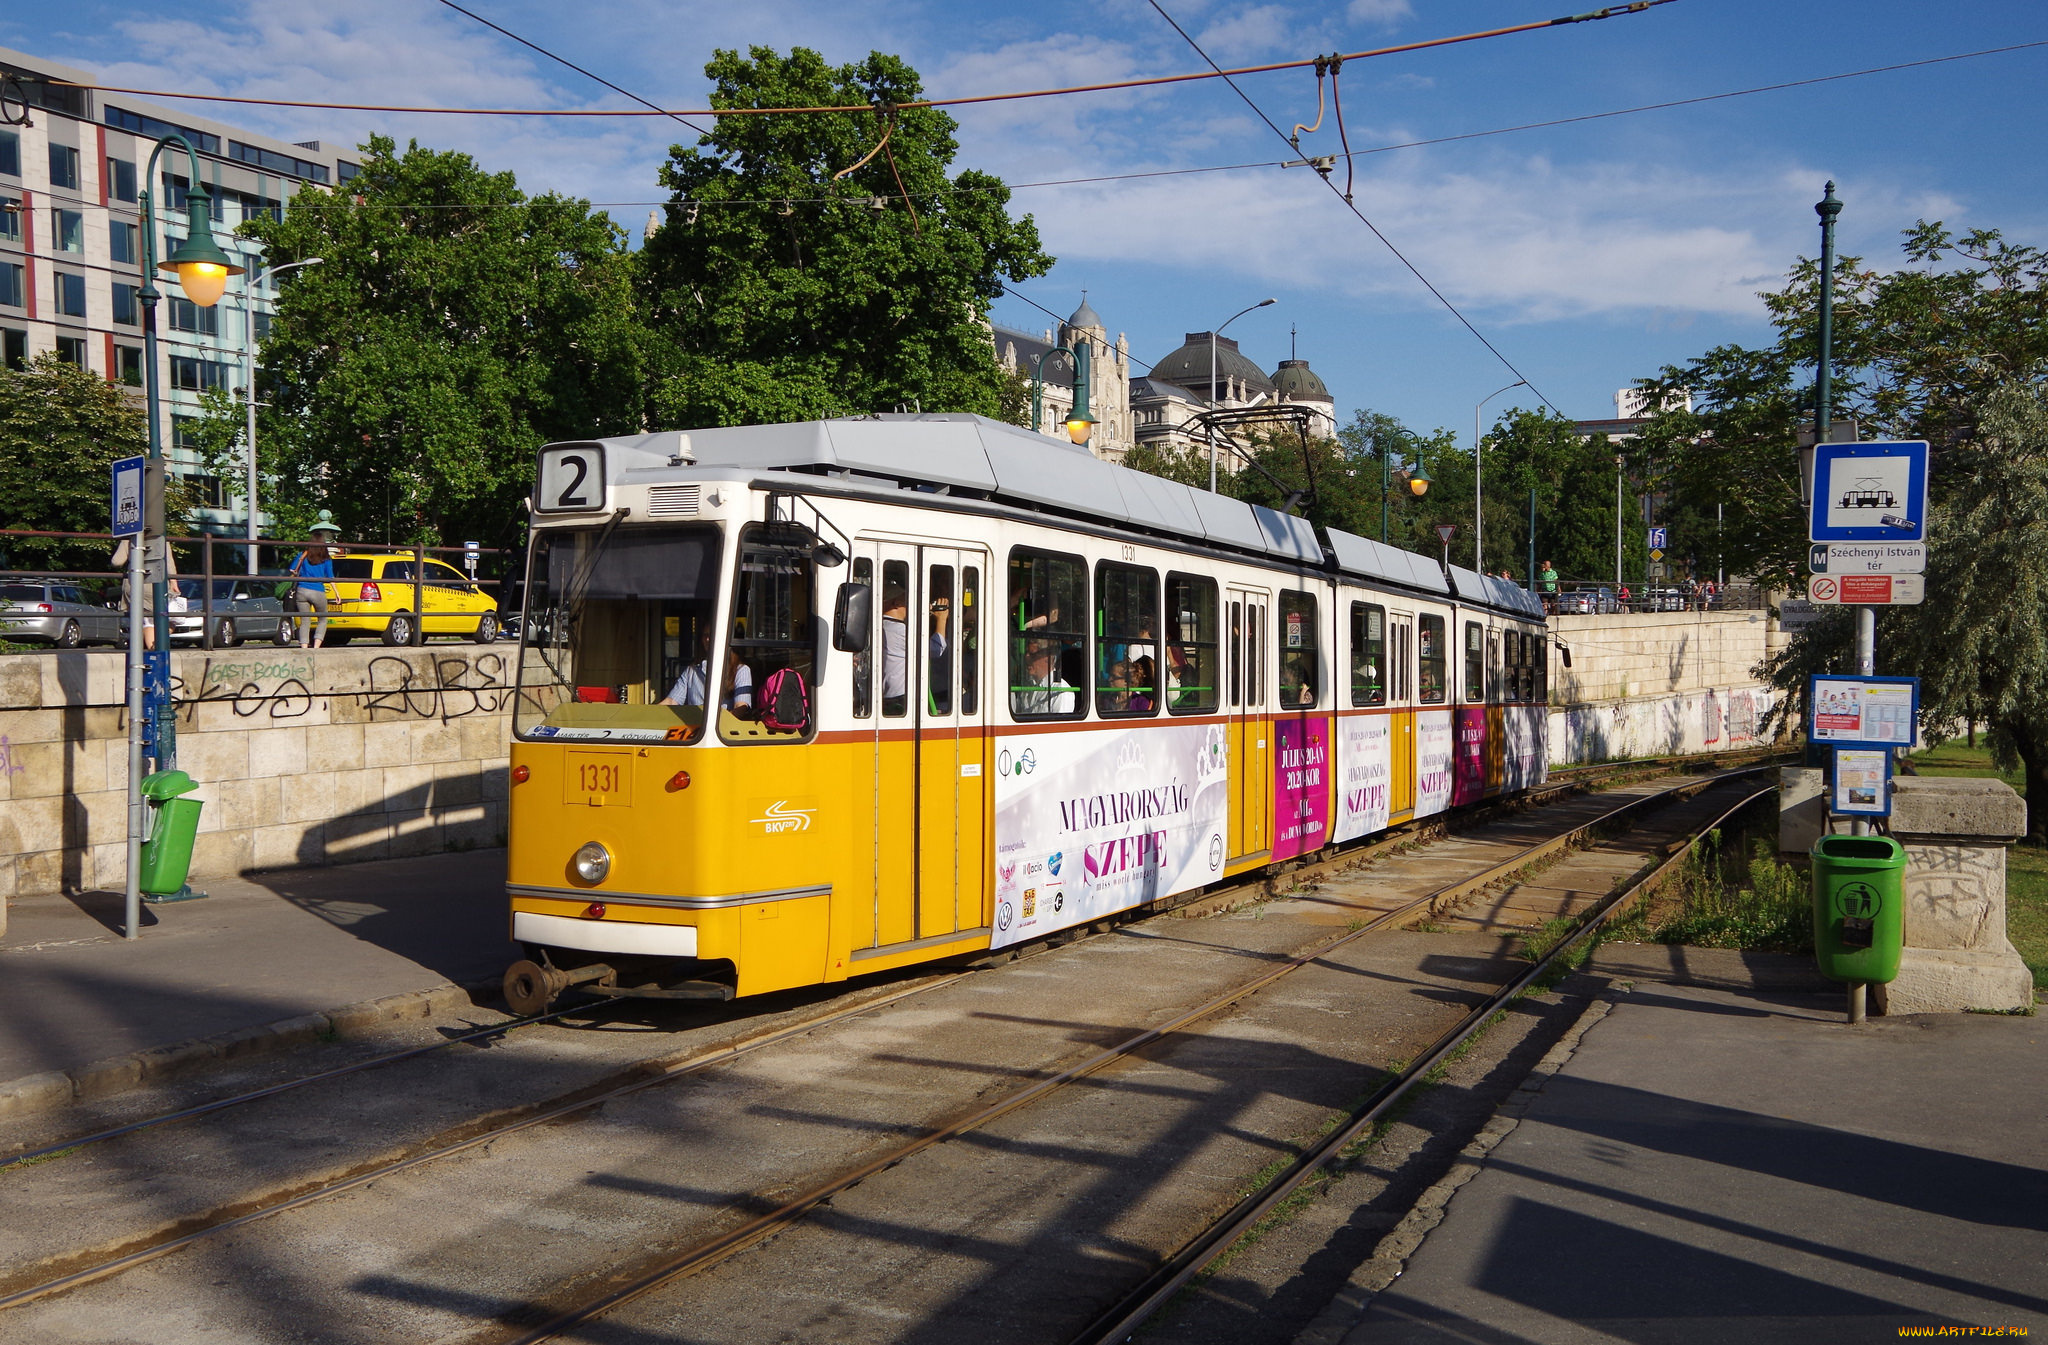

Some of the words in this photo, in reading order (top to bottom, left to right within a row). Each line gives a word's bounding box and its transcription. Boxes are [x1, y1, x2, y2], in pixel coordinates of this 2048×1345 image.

[558, 455, 588, 507] 2
[1121, 544, 1136, 562] 1331
[1814, 552, 1827, 566] M
[1831, 547, 1884, 560] Széchenyi
[1887, 546, 1921, 557] István
[1867, 560, 1883, 571] tér
[580, 764, 619, 792] 1331
[1058, 777, 1189, 835] MAGYARORSZÁG
[765, 822, 785, 833] BKV
[1083, 824, 1168, 889] SZÉPE
[1096, 880, 1111, 892] miss
[1112, 872, 1130, 886] world
[1131, 868, 1155, 881] hungary
